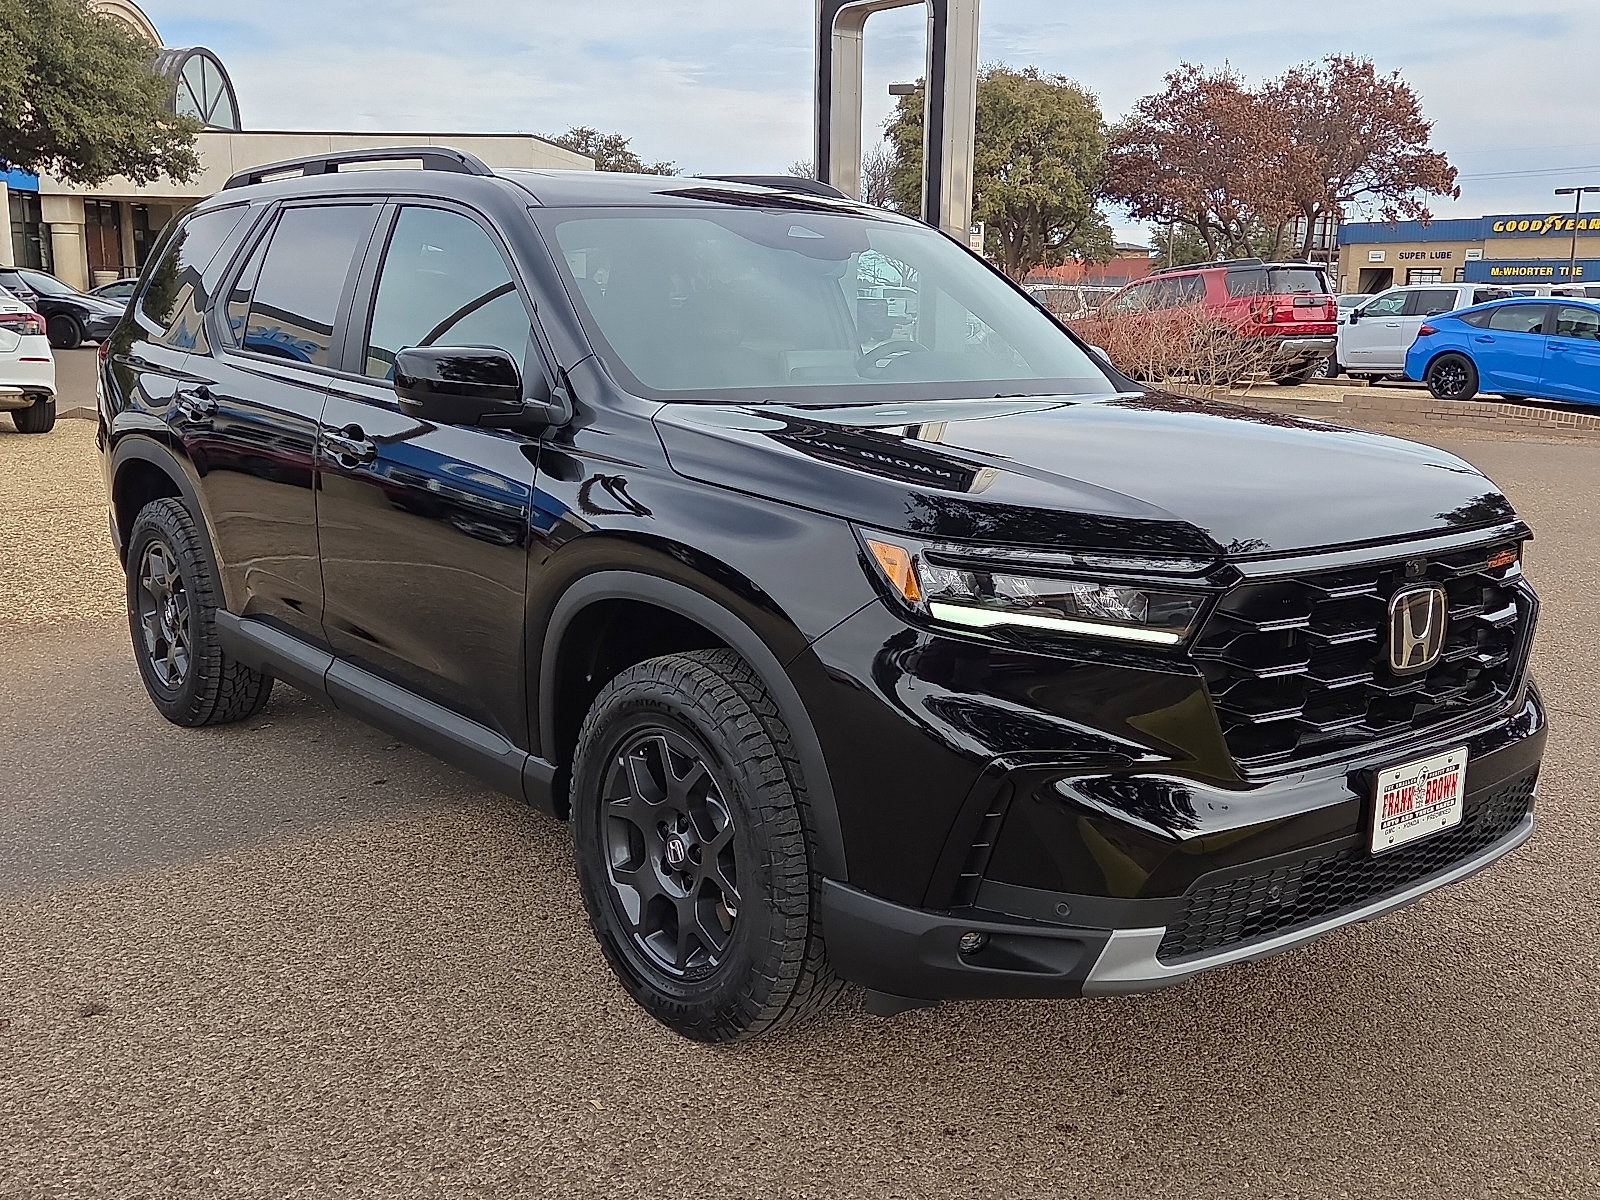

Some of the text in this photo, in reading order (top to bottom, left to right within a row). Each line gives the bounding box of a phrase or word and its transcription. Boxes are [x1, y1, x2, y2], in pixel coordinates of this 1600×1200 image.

[1398, 251, 1453, 260] SUPER LUBE
[1382, 773, 1459, 819] FRANK BROWN
[1384, 827, 1396, 836] GMC
